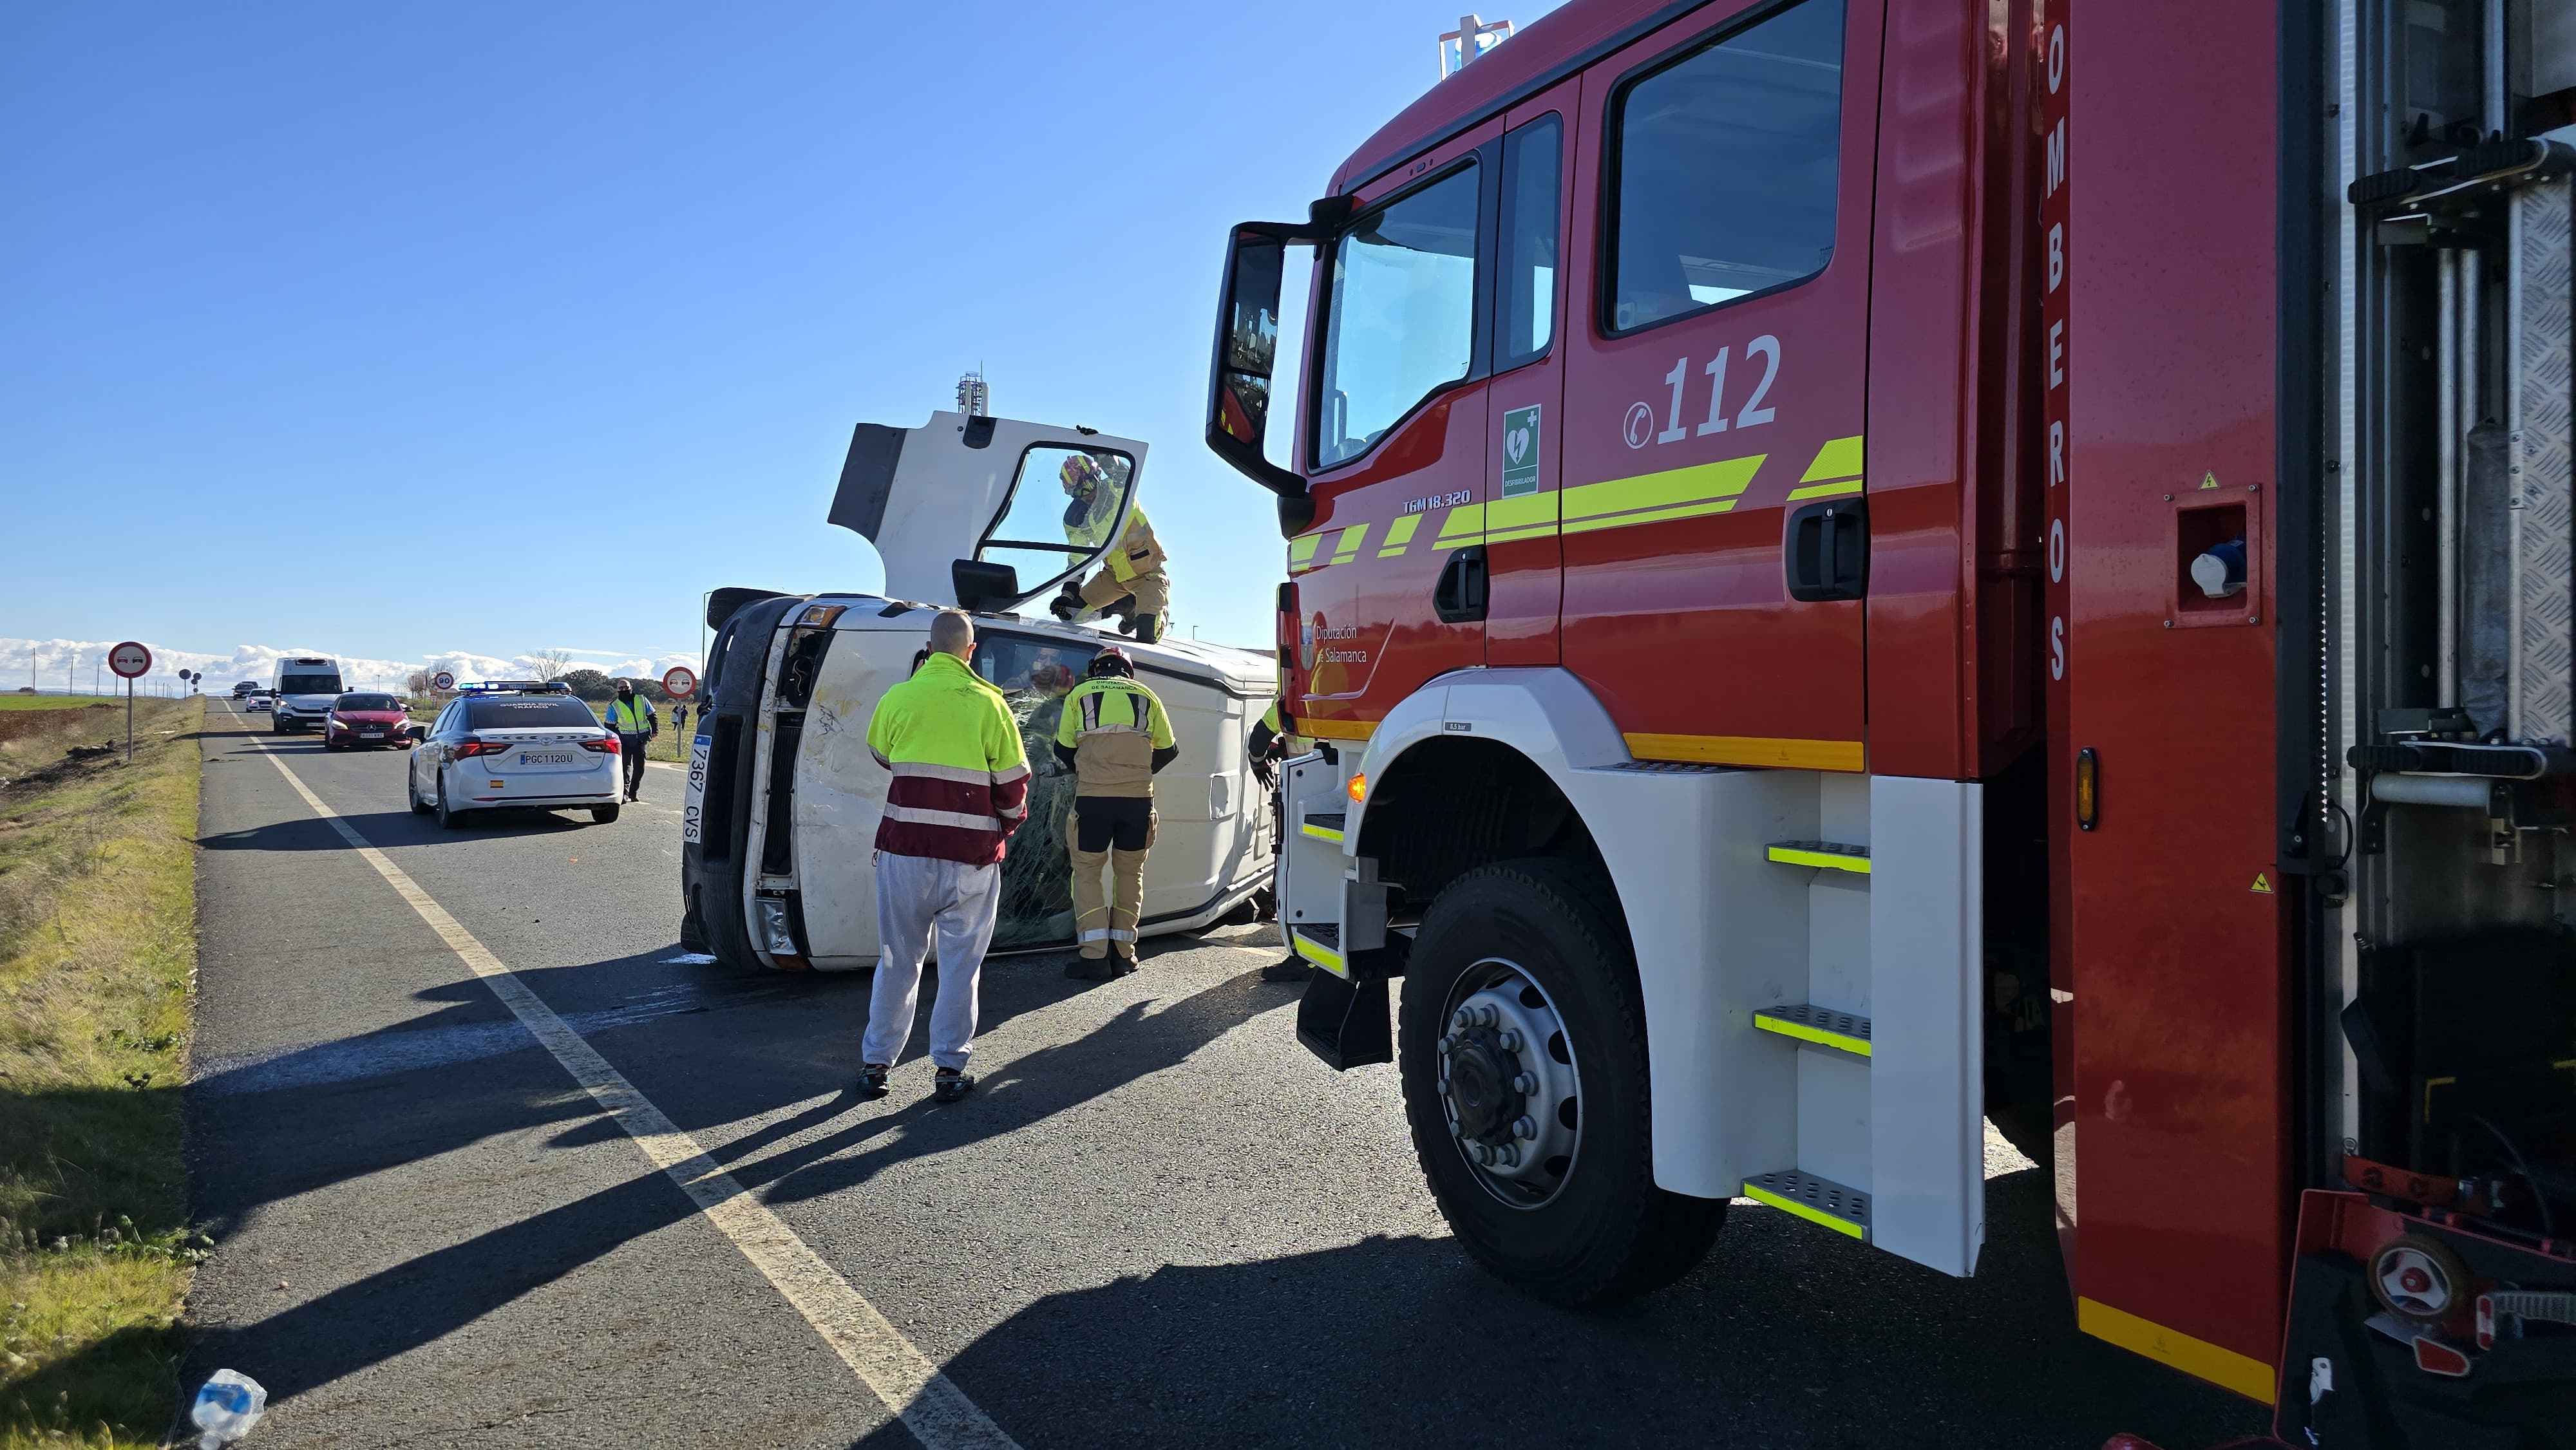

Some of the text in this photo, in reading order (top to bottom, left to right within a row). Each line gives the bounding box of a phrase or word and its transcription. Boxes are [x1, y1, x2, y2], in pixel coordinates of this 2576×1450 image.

[2047, 0, 2065, 681] OMBEROS
[1657, 334, 1781, 445] 112
[1504, 476, 1536, 487] DESFIBRILADOR
[1403, 489, 1471, 514] TGM 18.320
[1316, 623, 1357, 645] Diputación
[1325, 646, 1367, 663] Salamanca
[526, 755, 542, 764] PGC
[689, 748, 708, 793] 7367
[685, 805, 699, 838] CVS
